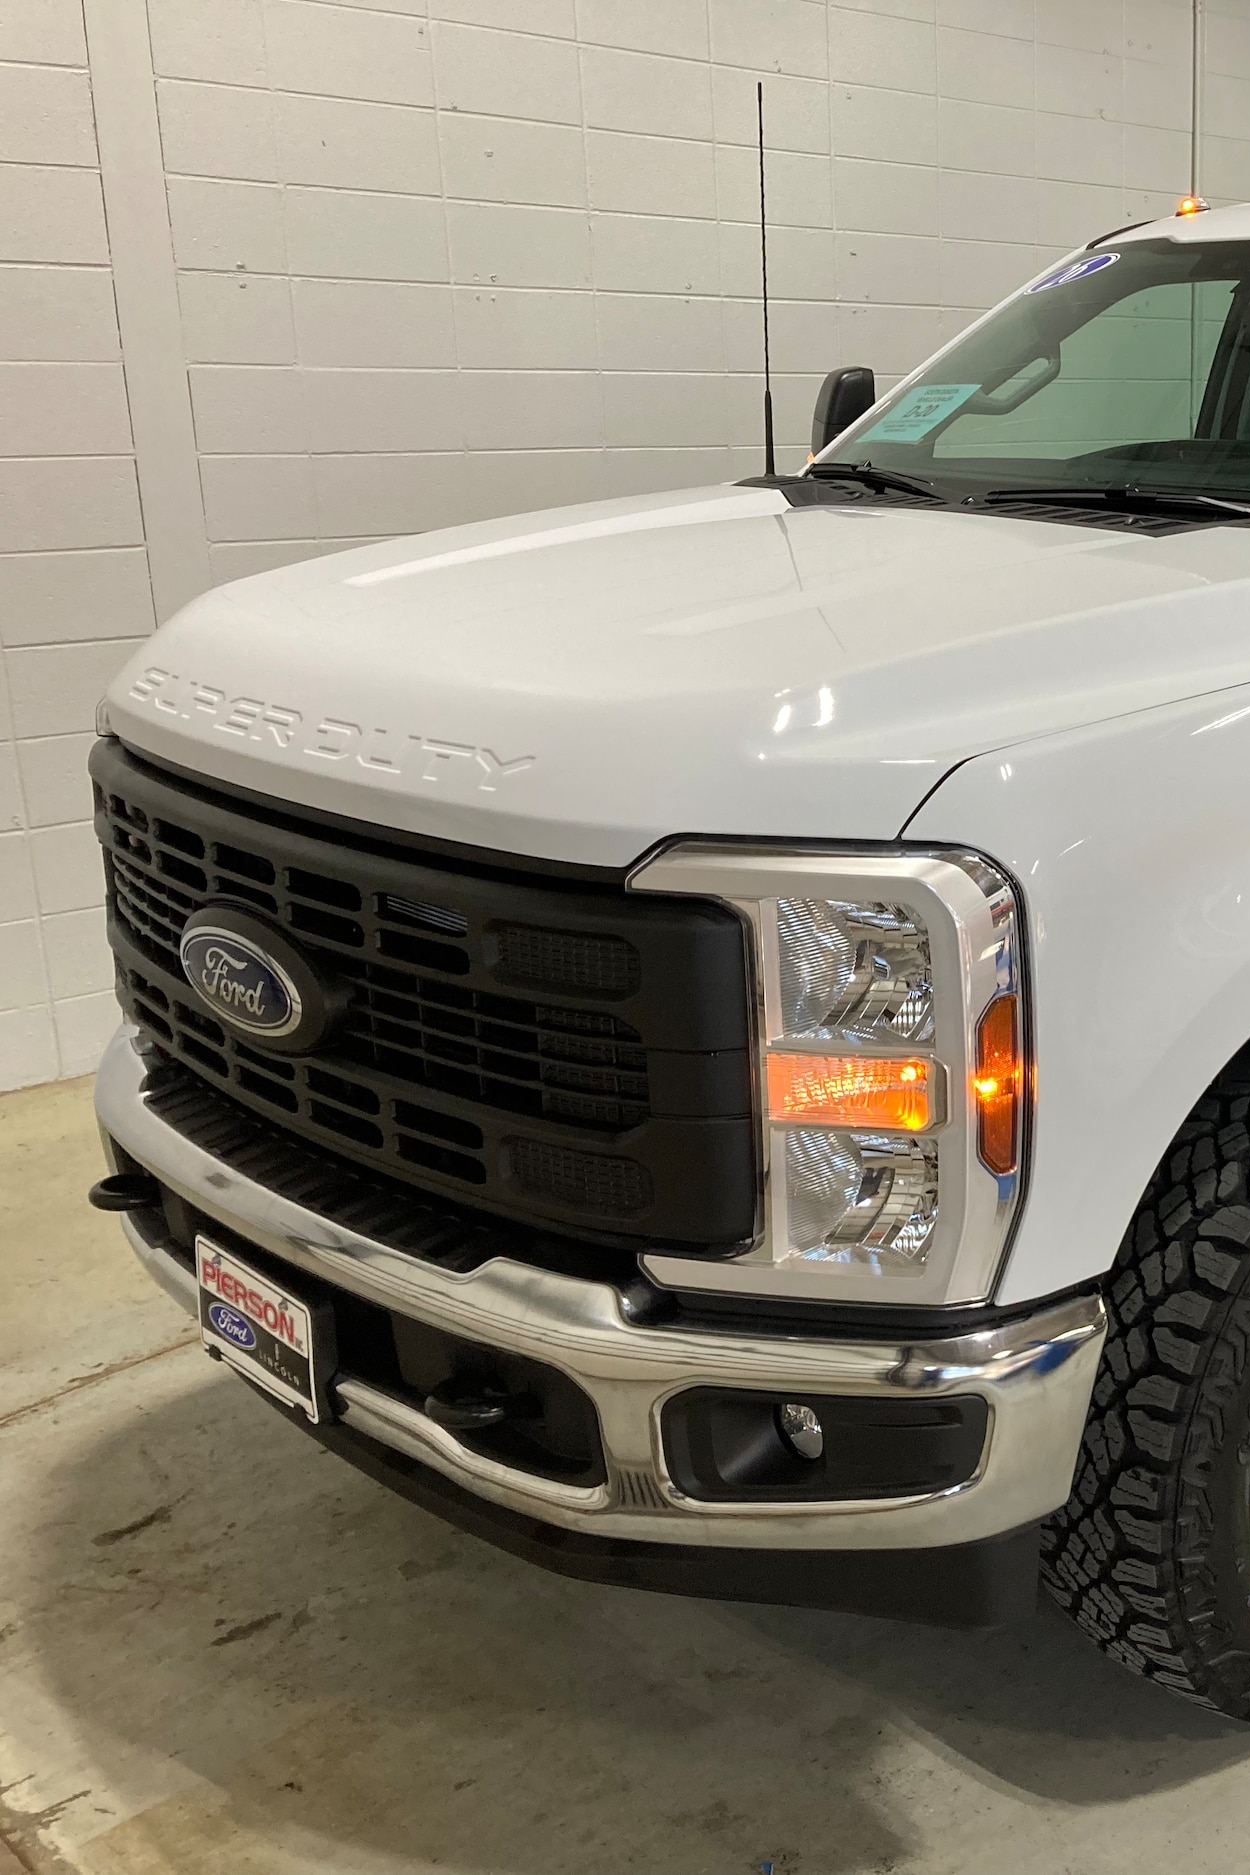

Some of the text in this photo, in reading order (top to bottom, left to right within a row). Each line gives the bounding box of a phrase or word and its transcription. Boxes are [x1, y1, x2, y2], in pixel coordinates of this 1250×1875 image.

[129, 666, 537, 792] SUPER DUTY
[201, 946, 266, 1016] Ford
[200, 1258, 296, 1344] PIERSON
[217, 1308, 249, 1343] Ford
[258, 1348, 301, 1387] LINCOLN
